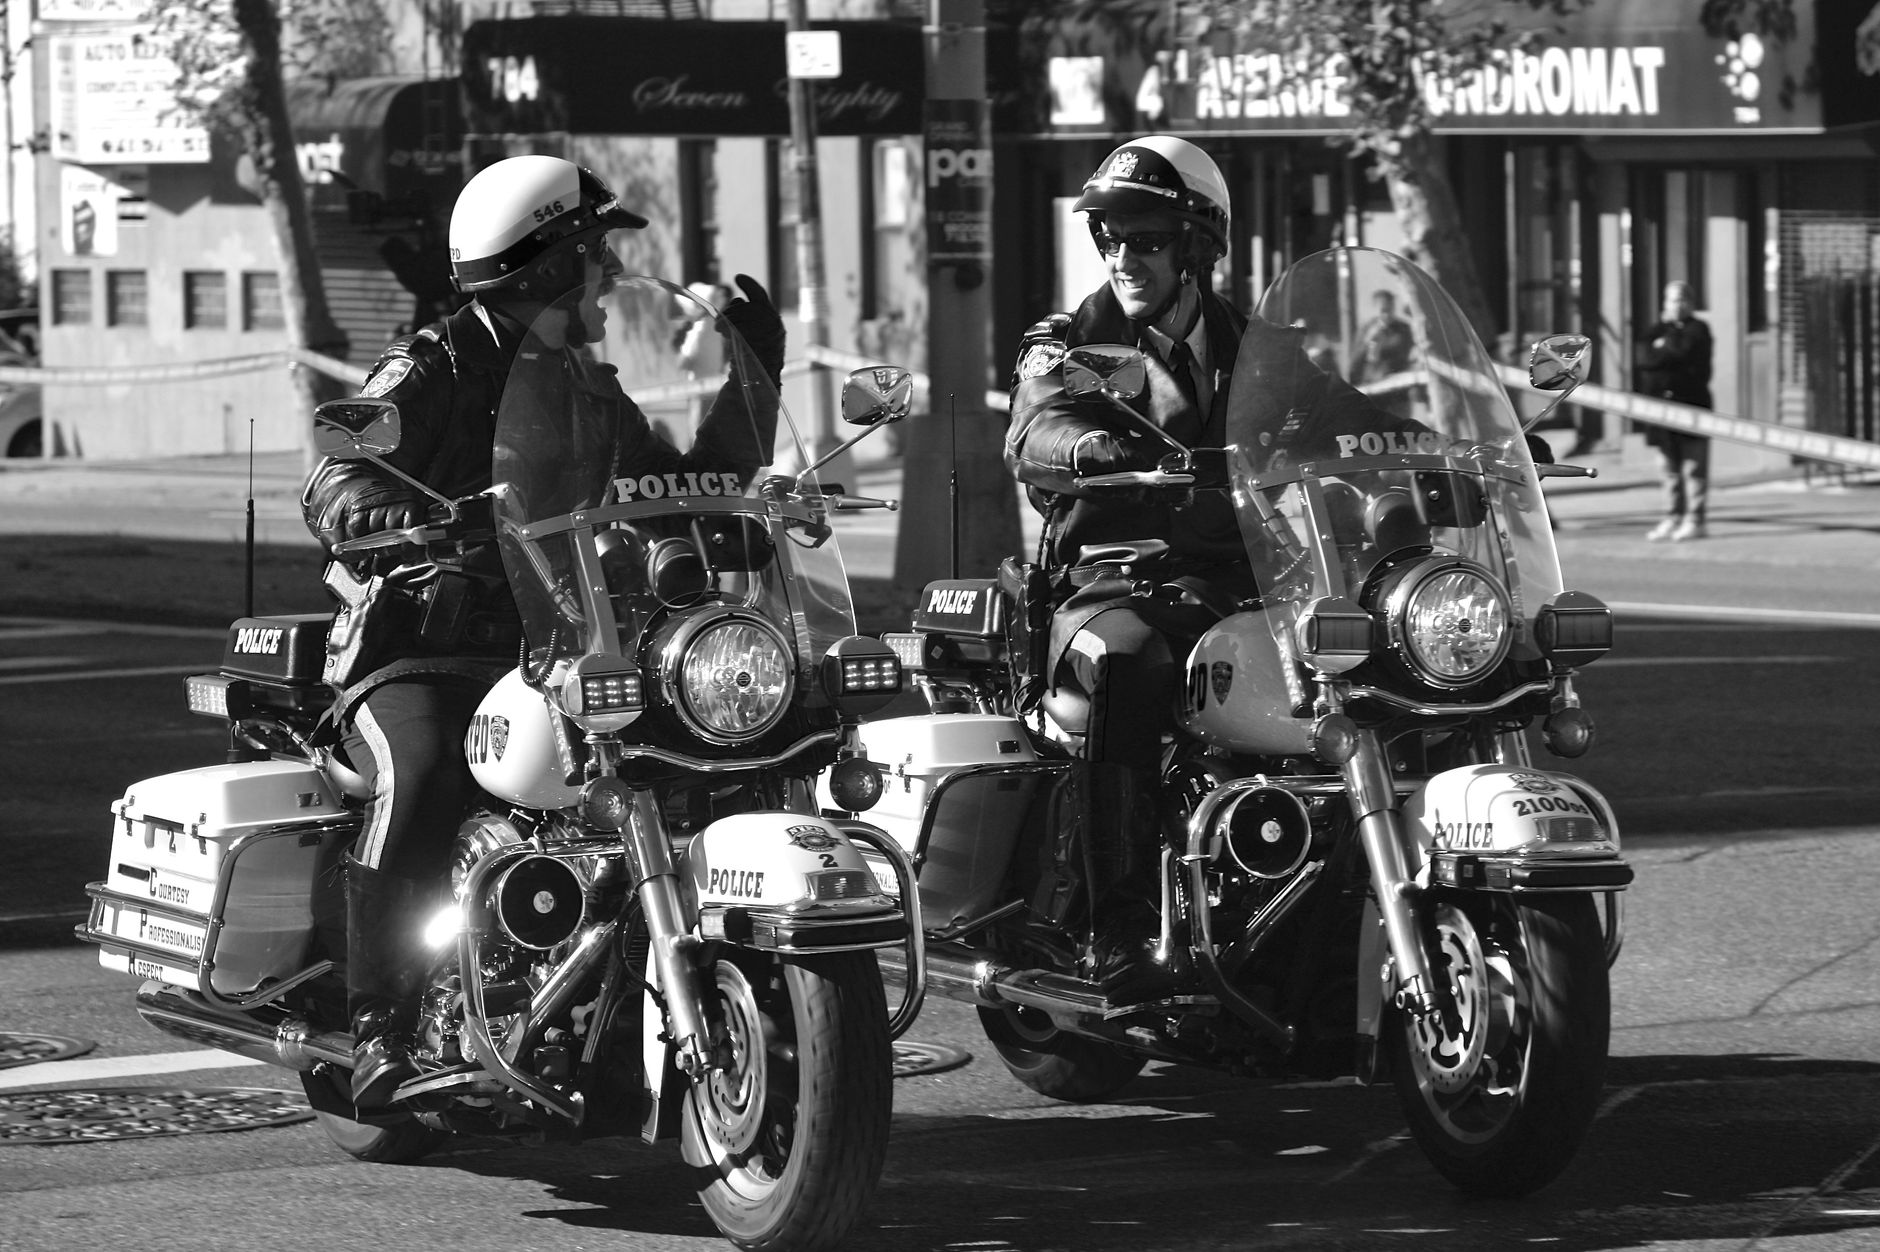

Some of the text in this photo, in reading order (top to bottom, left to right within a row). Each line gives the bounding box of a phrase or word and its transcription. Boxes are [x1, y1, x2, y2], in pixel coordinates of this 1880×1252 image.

[633, 75, 745, 110] Seven
[533, 201, 565, 223] 546
[450, 247, 461, 261] PD
[613, 472, 743, 503] POLICE
[927, 589, 978, 615] POLICE
[233, 628, 283, 655] POLICE
[1431, 823, 1494, 849] POLICE
[818, 853, 839, 869] 2
[150, 867, 190, 905] COURTESY
[708, 868, 765, 899] POLICE
[139, 909, 205, 952] PROFESSIONALIS
